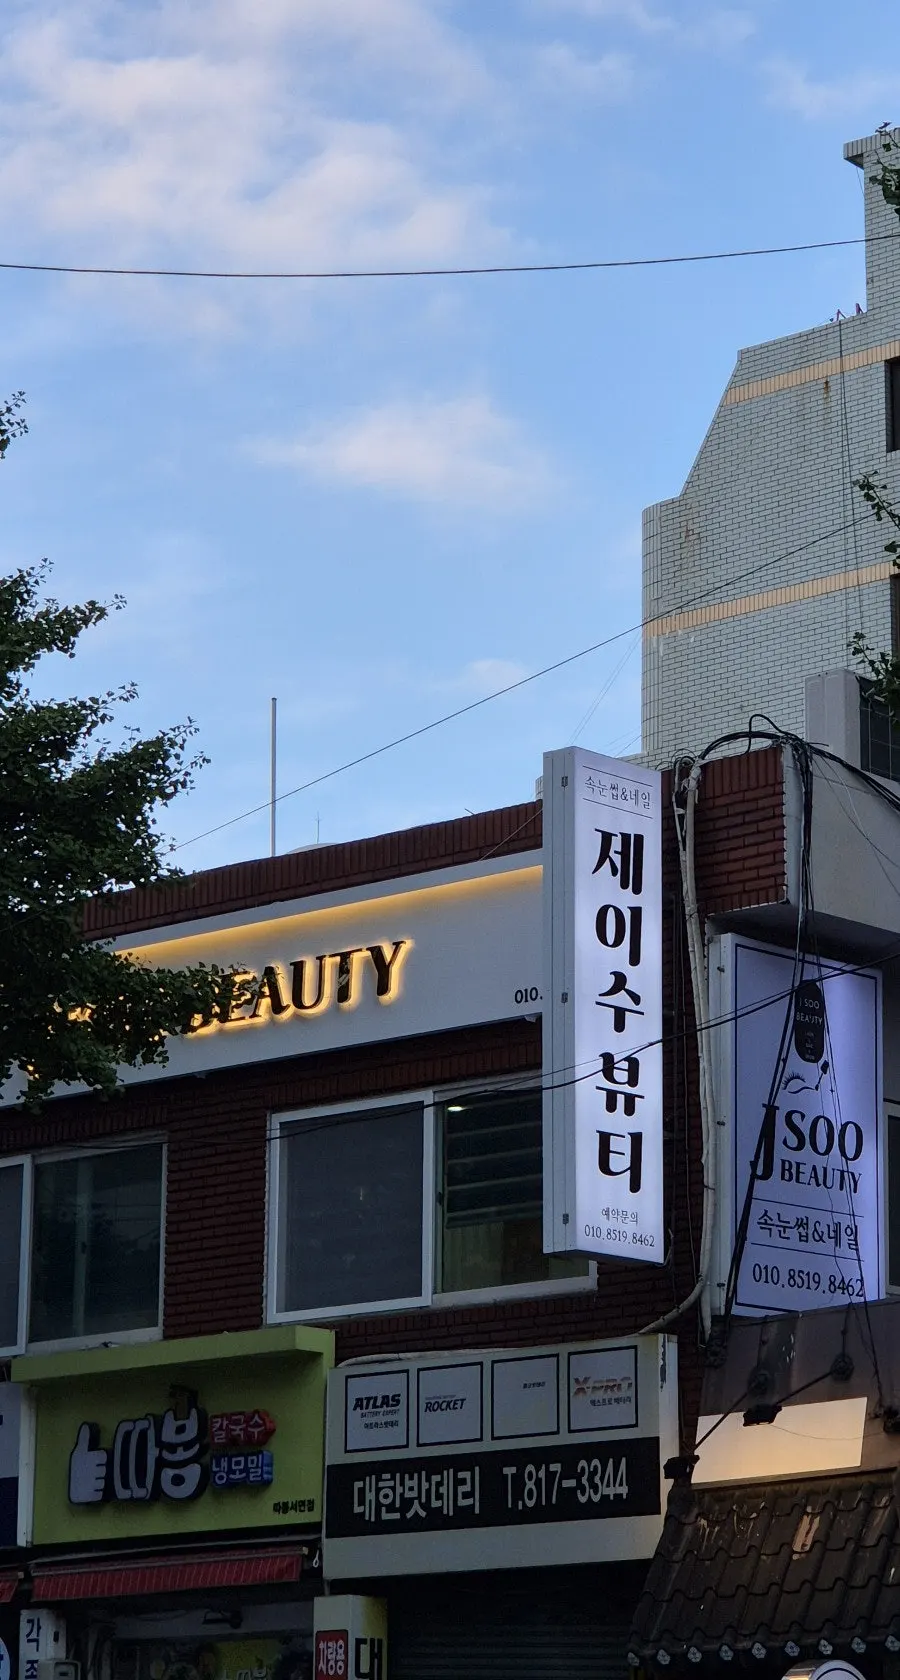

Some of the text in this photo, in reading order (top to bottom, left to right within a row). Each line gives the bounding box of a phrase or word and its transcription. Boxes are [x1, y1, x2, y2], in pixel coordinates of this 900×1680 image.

[585, 776, 651, 810] 속눈썹&네일
[592, 829, 645, 1193] 제이수뷰티
[780, 1159, 862, 1194] BEAUTY
[601, 1207, 638, 1226] 예약문의
[757, 1209, 858, 1251] 속눈썹&네일
[584, 1224, 655, 1247] 010.8519.8462
[752, 1263, 864, 1298] 010.8519.8462
[352, 1394, 401, 1411] ATLAS
[424, 1398, 466, 1412] ROCKET
[212, 1413, 266, 1443] 칼국수
[114, 1407, 203, 1500] 따봉
[212, 1453, 263, 1485] 냉모밀
[353, 1456, 629, 1522] 대한밧데리 T.817-3344
